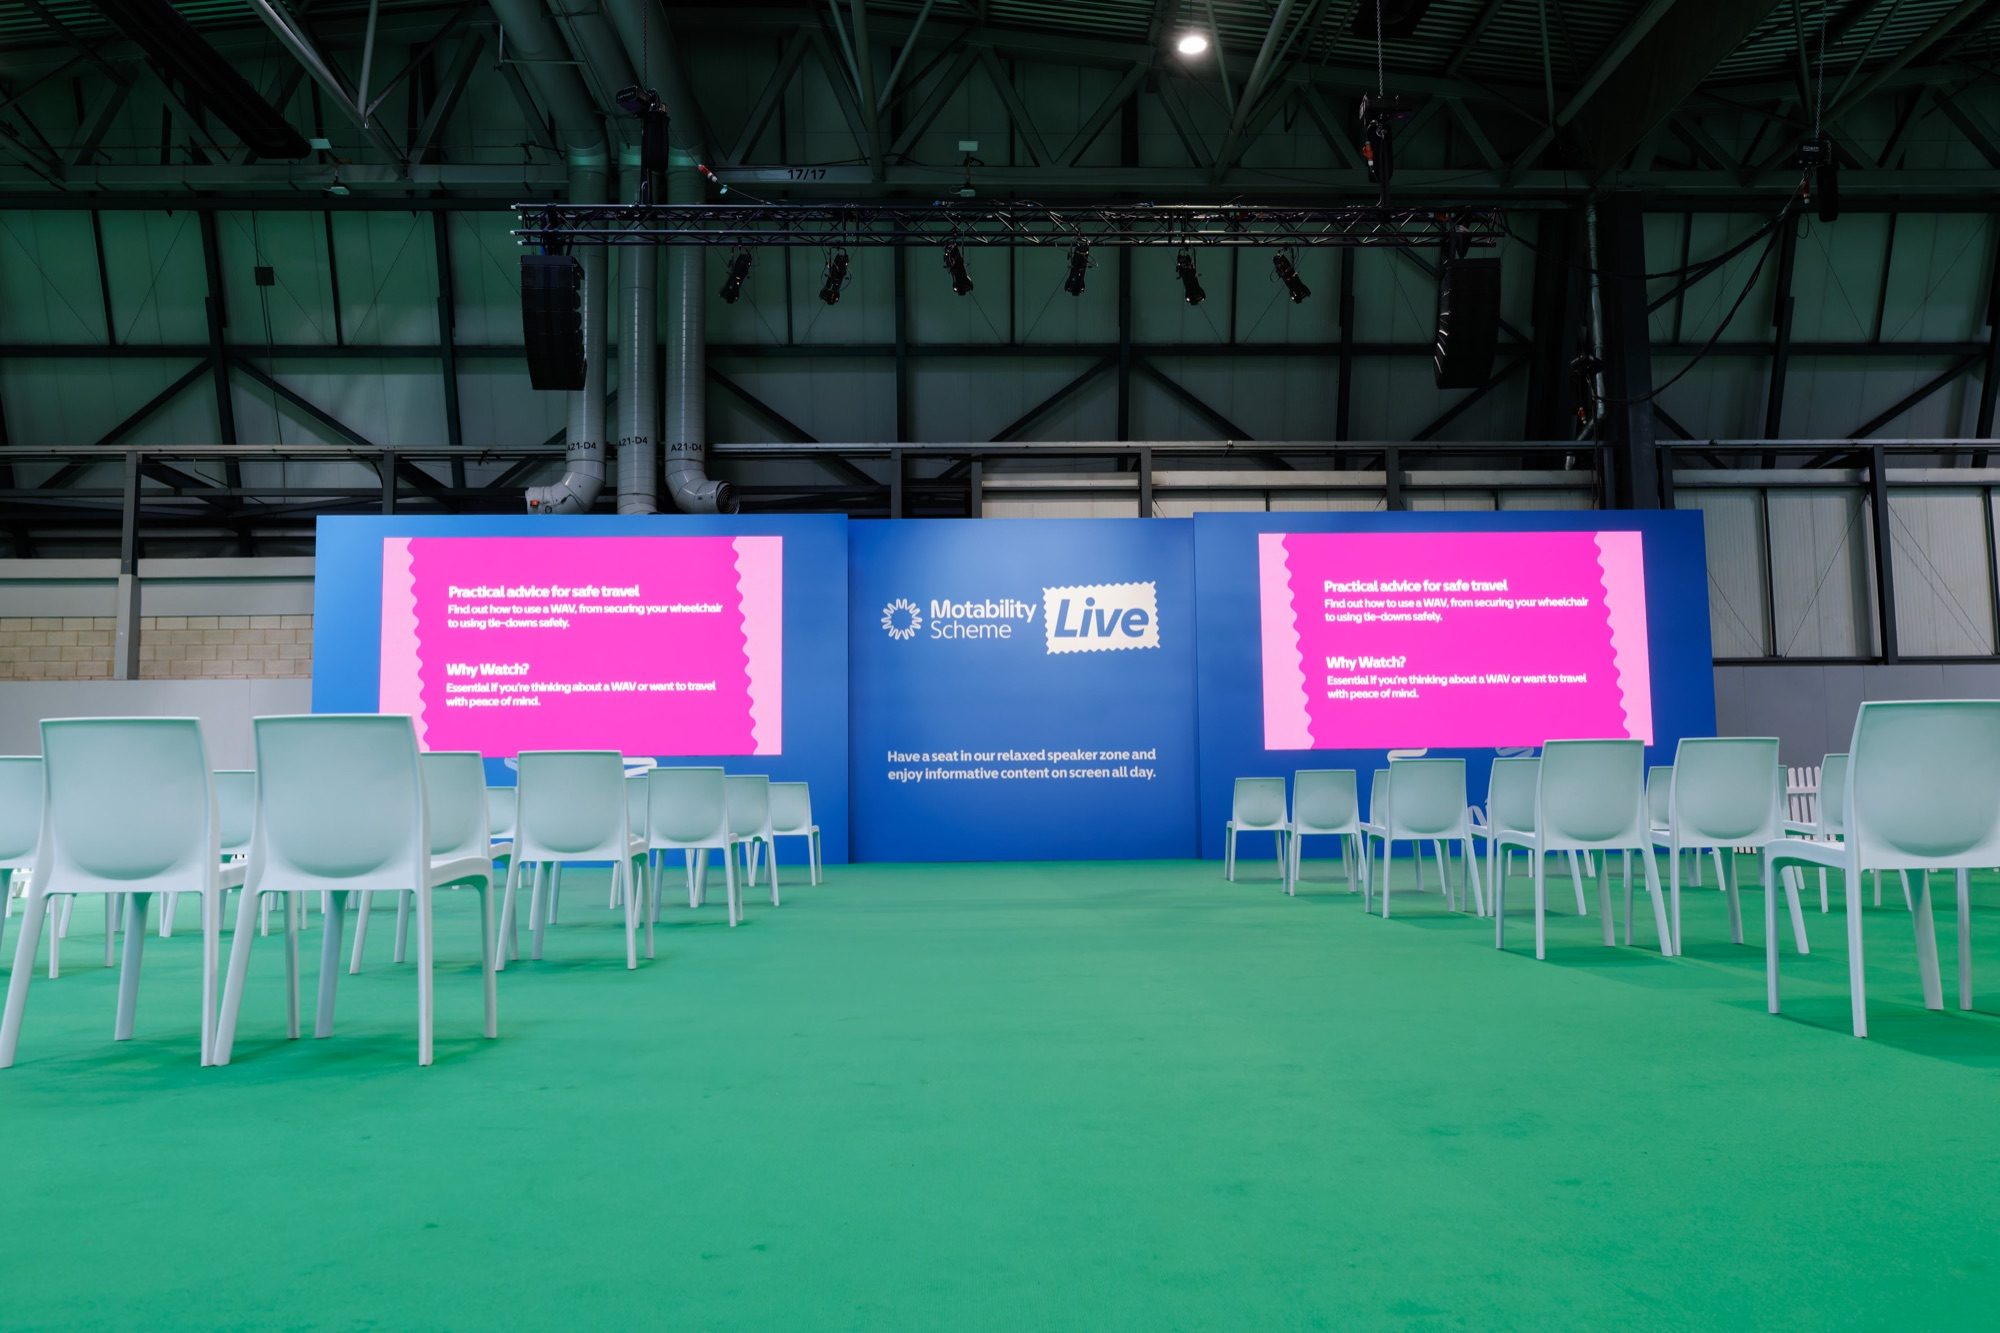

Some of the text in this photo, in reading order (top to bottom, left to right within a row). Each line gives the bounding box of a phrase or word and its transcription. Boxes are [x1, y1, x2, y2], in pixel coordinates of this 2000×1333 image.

[788, 169, 826, 180] 17/17
[448, 584, 640, 598] Practical advice for safe travel
[1324, 579, 1508, 593] Practical advice for safe travel
[448, 603, 723, 615] Find out how to use a WAV, from securing your wheelchair
[1324, 597, 1589, 609] Find out how to use a WAV, from securing your wheelchair
[930, 599, 1037, 623] Motability
[1054, 596, 1150, 638] Live
[1324, 611, 1443, 624] to using tie-downs safely.
[448, 617, 570, 630] to using tie-downs safely.
[930, 620, 1012, 639] Scheme
[1326, 656, 1407, 671] Why Watch?
[446, 663, 530, 679] Why Watch?
[446, 680, 717, 694] Essential if you're thinking about a WAV or want to travel
[1327, 673, 1588, 687] Essential if you're thinking about a WAV or want to travel
[1327, 688, 1420, 701] with peace of mind.
[446, 696, 541, 708] with peace of mind.
[887, 748, 1156, 763] Have a seat in our relaxed speaker zone and
[888, 765, 1157, 783] enjoy informative content on screen all day.
